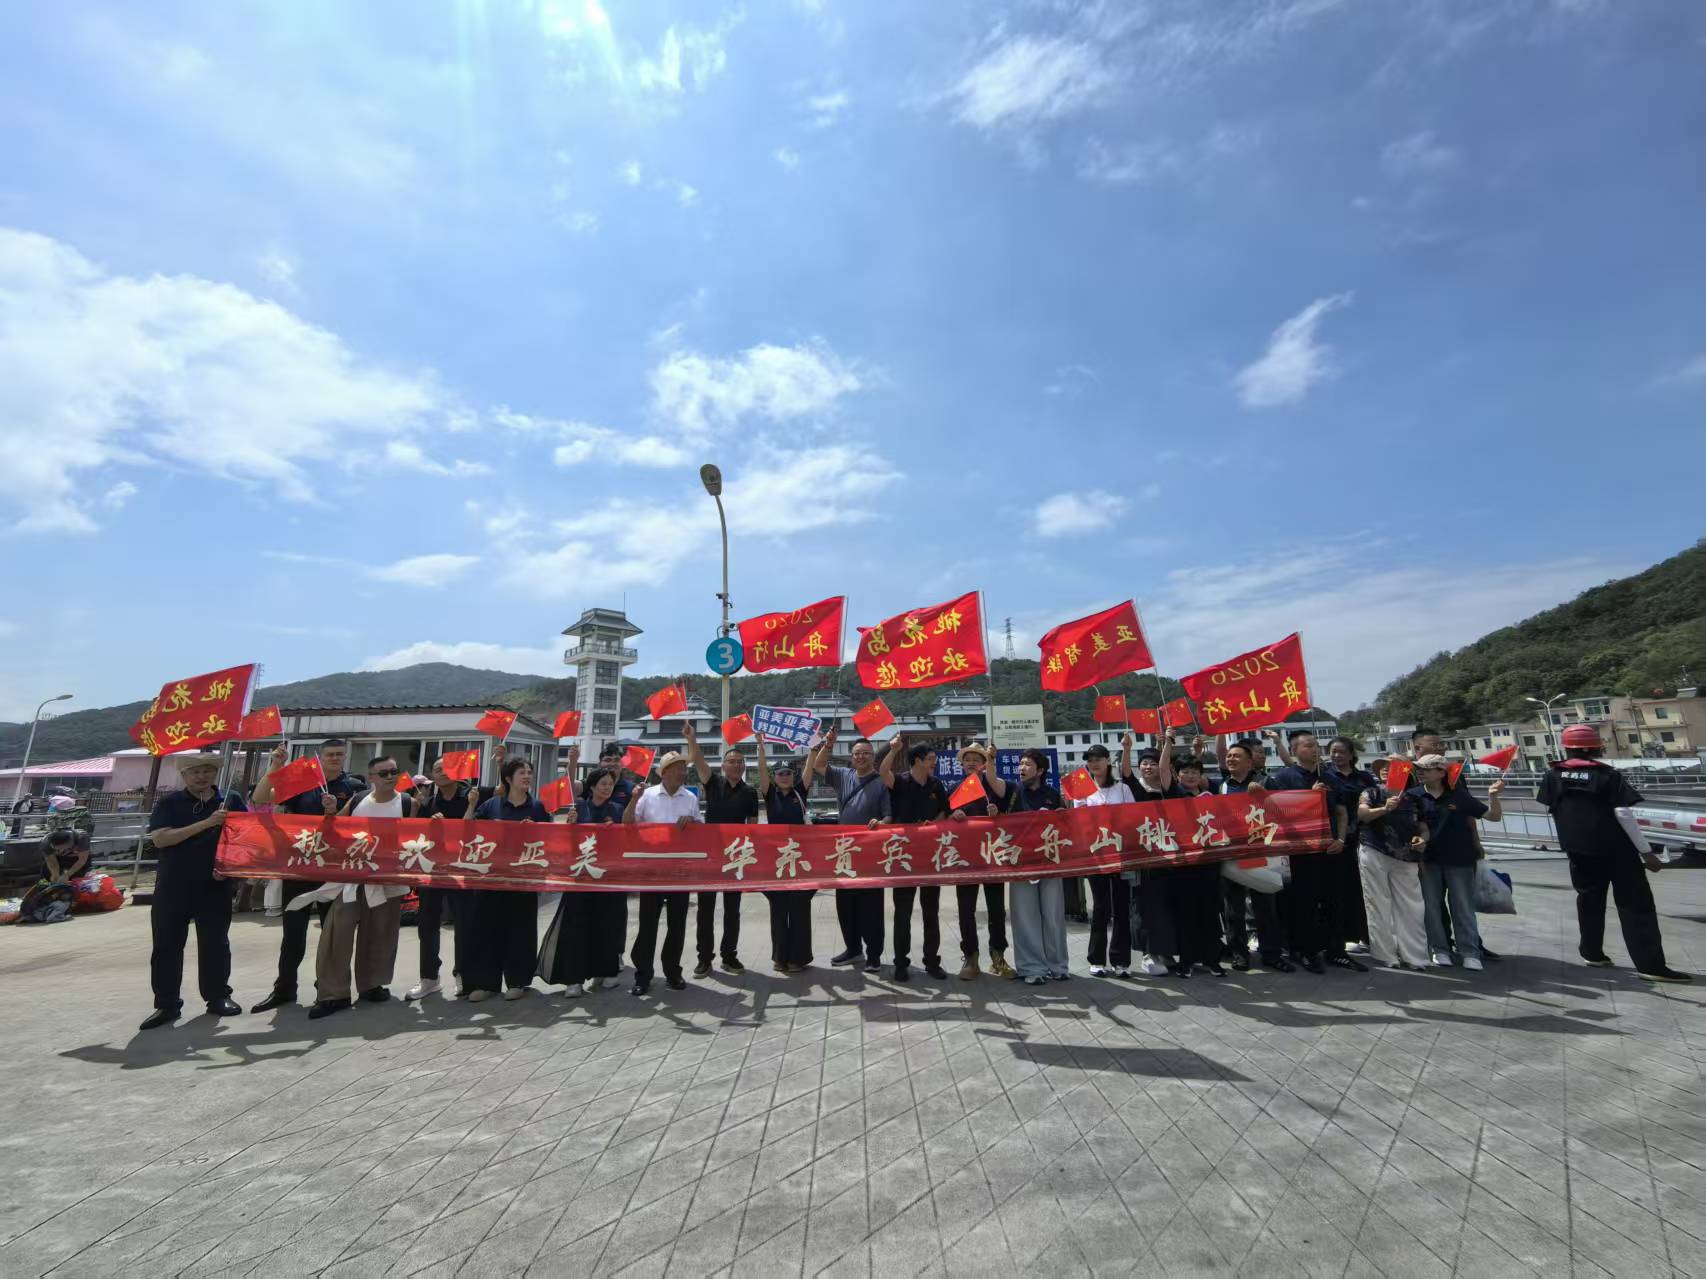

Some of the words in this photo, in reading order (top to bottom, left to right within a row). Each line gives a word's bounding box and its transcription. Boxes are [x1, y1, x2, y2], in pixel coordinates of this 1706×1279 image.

[717, 642, 735, 669] 3
[759, 708, 815, 731] 亚美亚美
